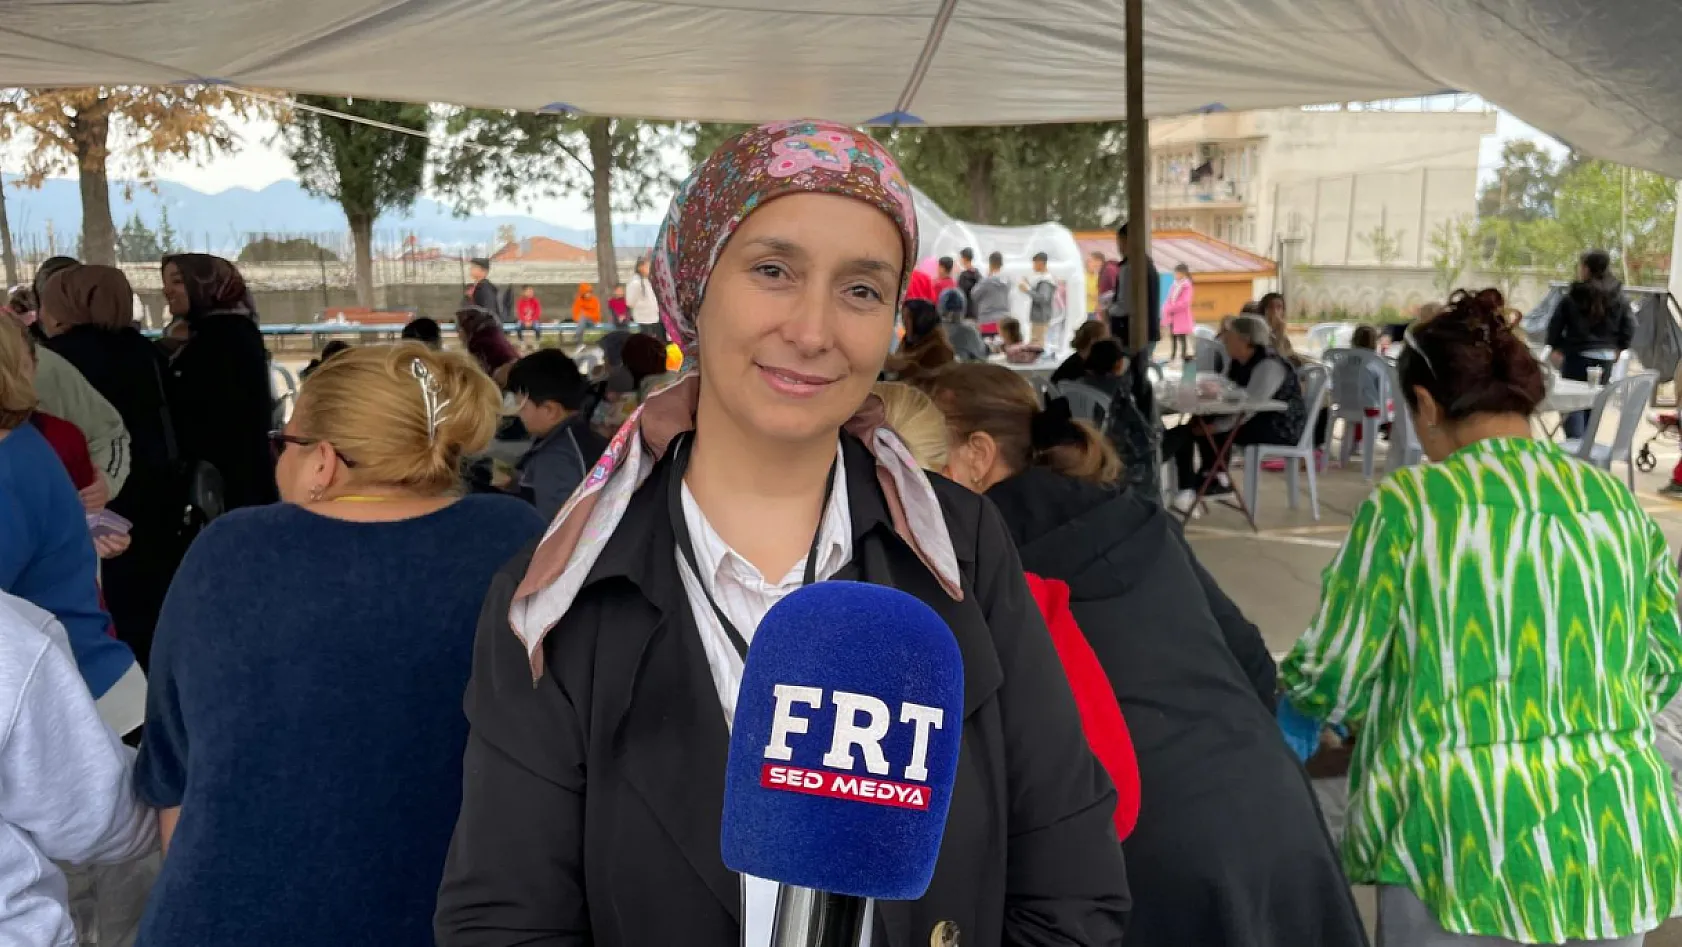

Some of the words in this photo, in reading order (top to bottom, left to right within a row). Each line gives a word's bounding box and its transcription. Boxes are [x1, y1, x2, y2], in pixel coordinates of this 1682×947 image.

[764, 684, 943, 781] FRT
[769, 766, 824, 789] SED
[831, 776, 924, 806] MEDYA
